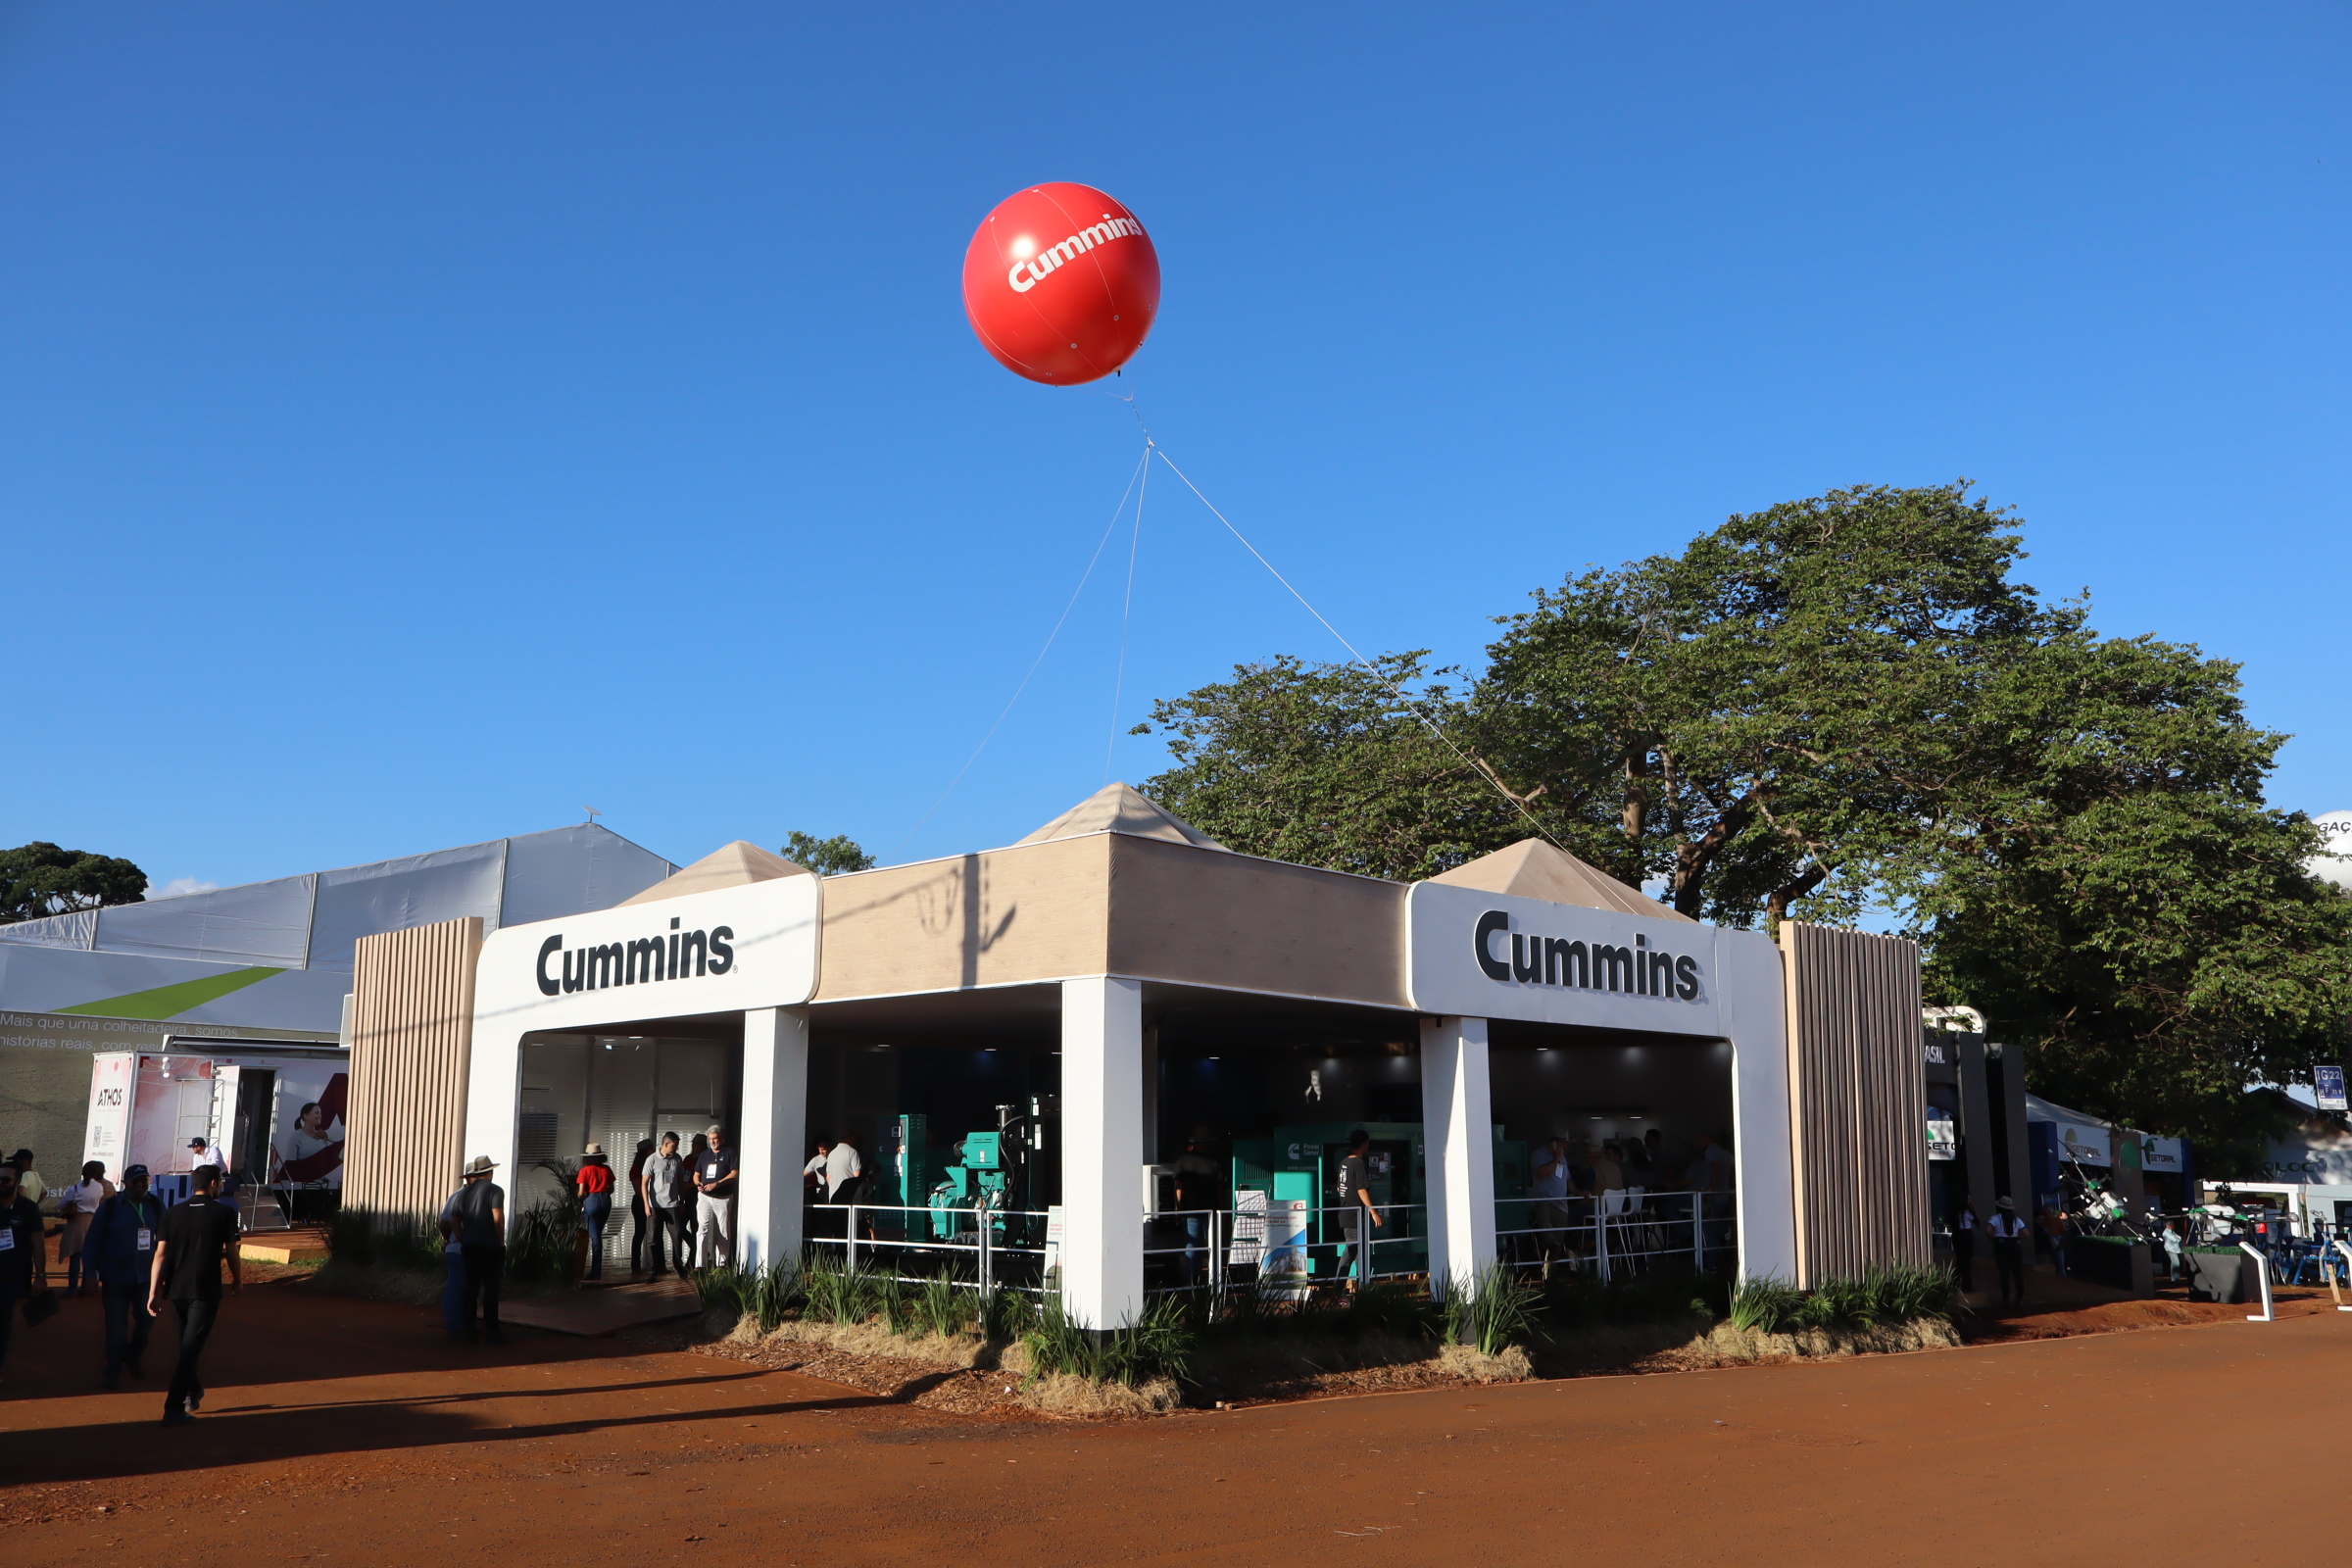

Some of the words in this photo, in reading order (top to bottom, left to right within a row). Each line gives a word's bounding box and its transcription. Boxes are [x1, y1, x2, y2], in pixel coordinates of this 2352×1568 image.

[1008, 213, 1143, 293] Cummins
[2318, 821, 2352, 834] GAÇ
[536, 916, 734, 997] Cummins
[1473, 909, 1698, 1001] Cummins
[0, 1013, 33, 1027] Mais
[37, 1018, 65, 1030] que
[69, 1020, 99, 1031] uma
[103, 1020, 190, 1036] colheitadeira,
[195, 1026, 238, 1038] somos
[60, 1038, 96, 1052] reais,
[101, 1041, 132, 1052] com
[97, 1088, 122, 1106] ATHOS
[2071, 1145, 2102, 1157] SETORIAL
[2150, 1153, 2177, 1164] SETORIAL
